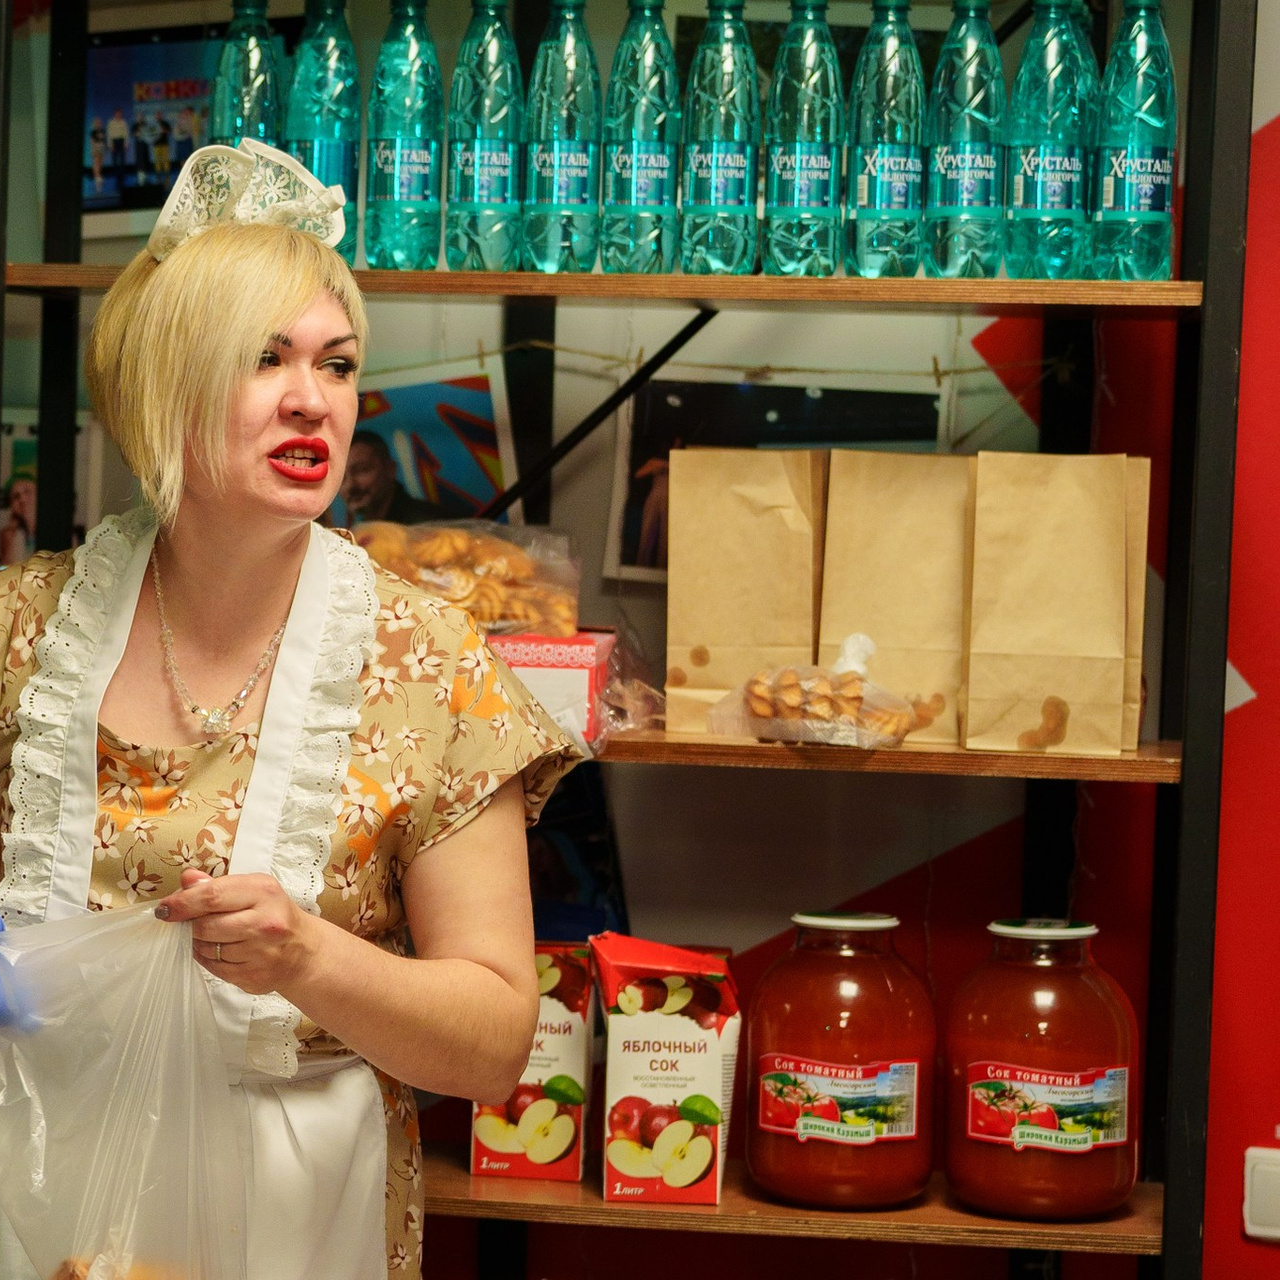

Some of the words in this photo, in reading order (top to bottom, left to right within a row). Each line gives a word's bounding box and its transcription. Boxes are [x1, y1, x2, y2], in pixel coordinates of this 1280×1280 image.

[375, 141, 431, 169] ХРУТАЛЬ
[454, 143, 511, 170] ХРУТАЛЬ
[611, 146, 670, 173] ХРУТАЛЬ
[622, 1039, 707, 1053] ЯБЛОЧНЫЙ
[649, 1059, 679, 1072] СОК
